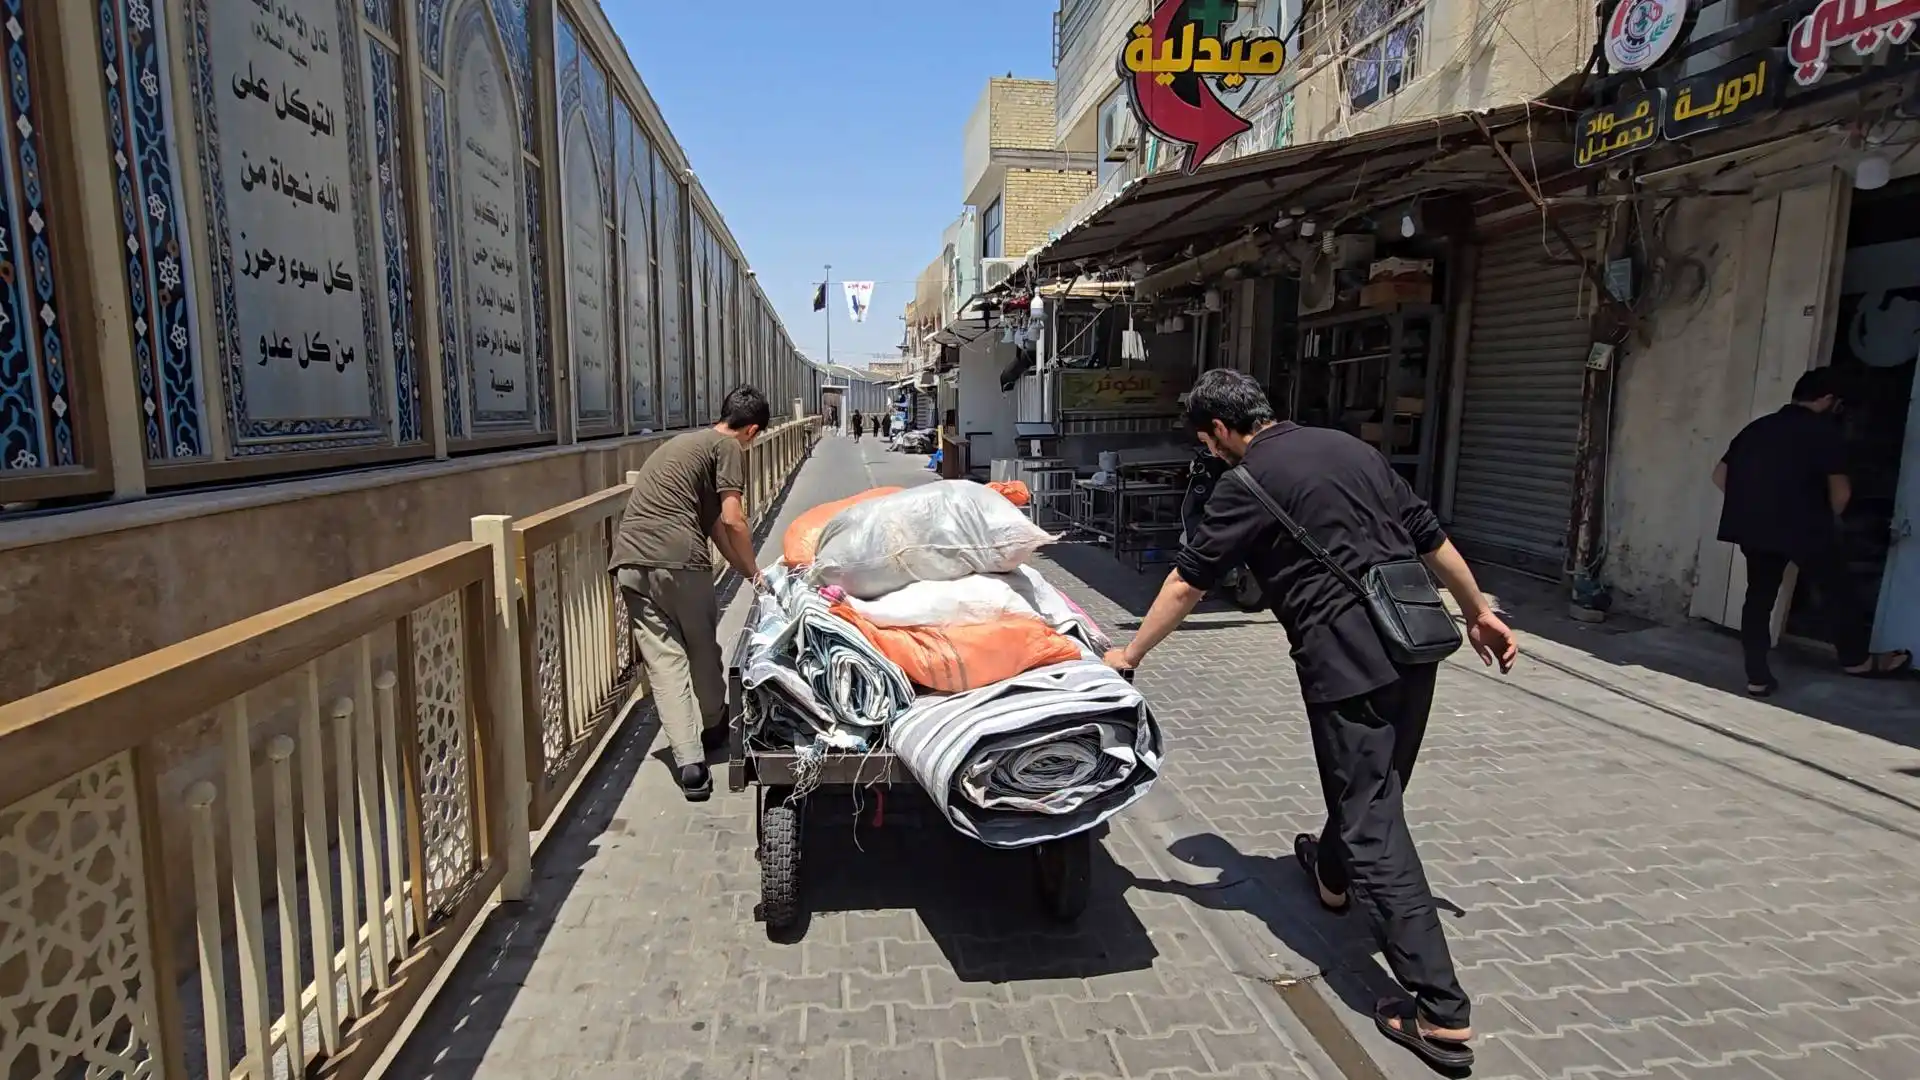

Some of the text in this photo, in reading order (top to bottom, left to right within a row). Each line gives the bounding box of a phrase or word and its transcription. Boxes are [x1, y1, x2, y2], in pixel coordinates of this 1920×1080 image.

[1124, 23, 1284, 86] صيدلية
[231, 60, 335, 137] التوكل على
[1675, 60, 1767, 121] ادوية
[1584, 100, 1650, 137] مواد
[240, 149, 341, 214] الله نجاة من
[290, 258, 319, 289] سوء
[323, 257, 354, 295] كل
[257, 328, 355, 373] من كل عدو
